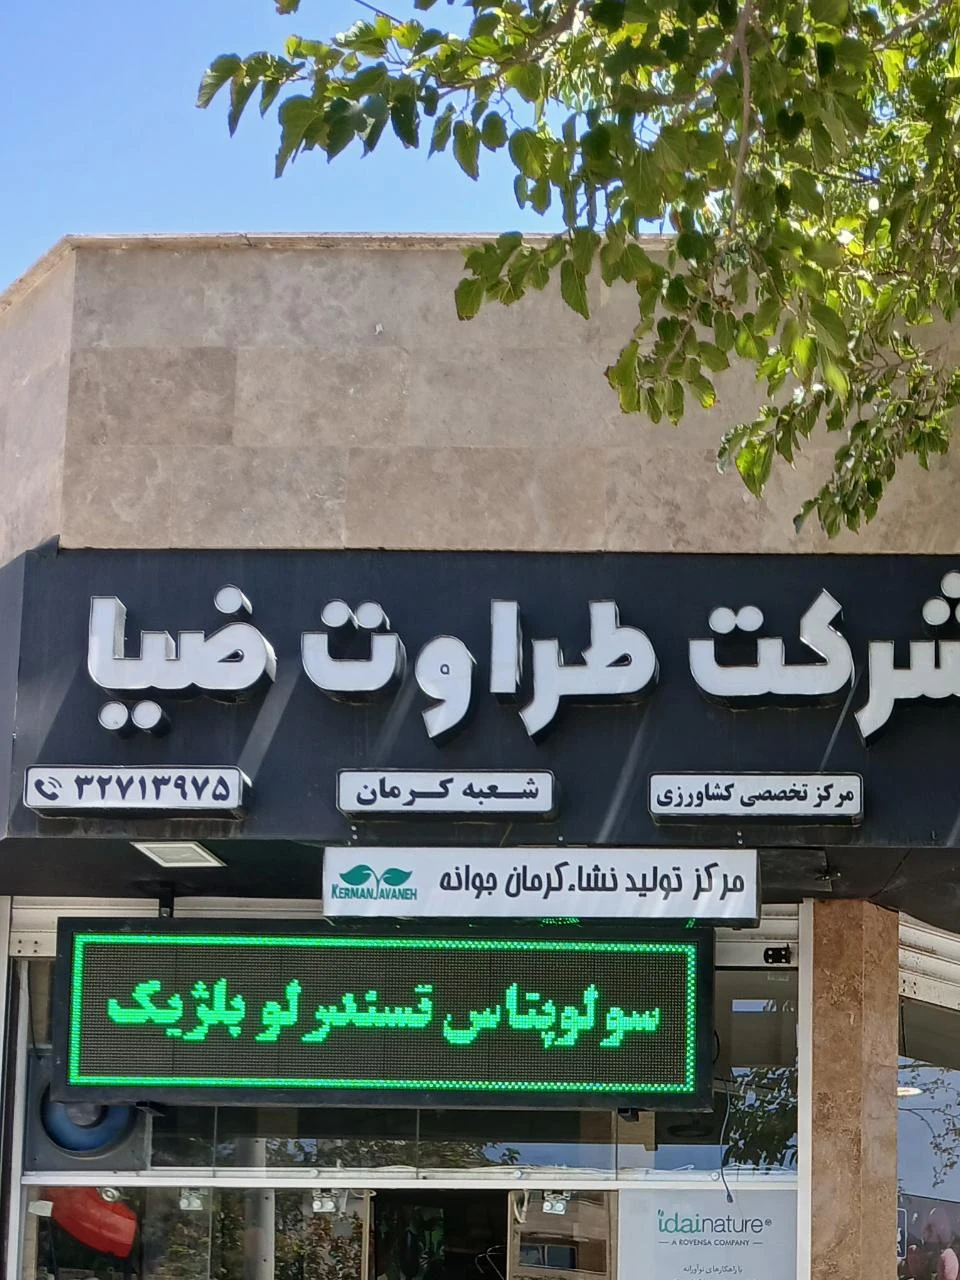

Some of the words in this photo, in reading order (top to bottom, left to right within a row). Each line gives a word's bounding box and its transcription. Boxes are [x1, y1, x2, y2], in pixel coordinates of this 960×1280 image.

[88, 584, 277, 731] ضیا
[301, 599, 658, 740] طراوت
[74, 775, 231, 802] ۳۲۷۱۳۹۷۵
[355, 778, 453, 806] کرمان
[461, 777, 540, 804] شعبه
[656, 782, 735, 808] کشاورزی
[740, 784, 808, 807] تخصصی
[813, 783, 854, 807] مرکز
[439, 865, 498, 899] جوانه
[505, 861, 569, 900] کرمان
[625, 866, 683, 900] تولید
[693, 862, 746, 900] مرکز
[108, 978, 246, 1042] بلژیک
